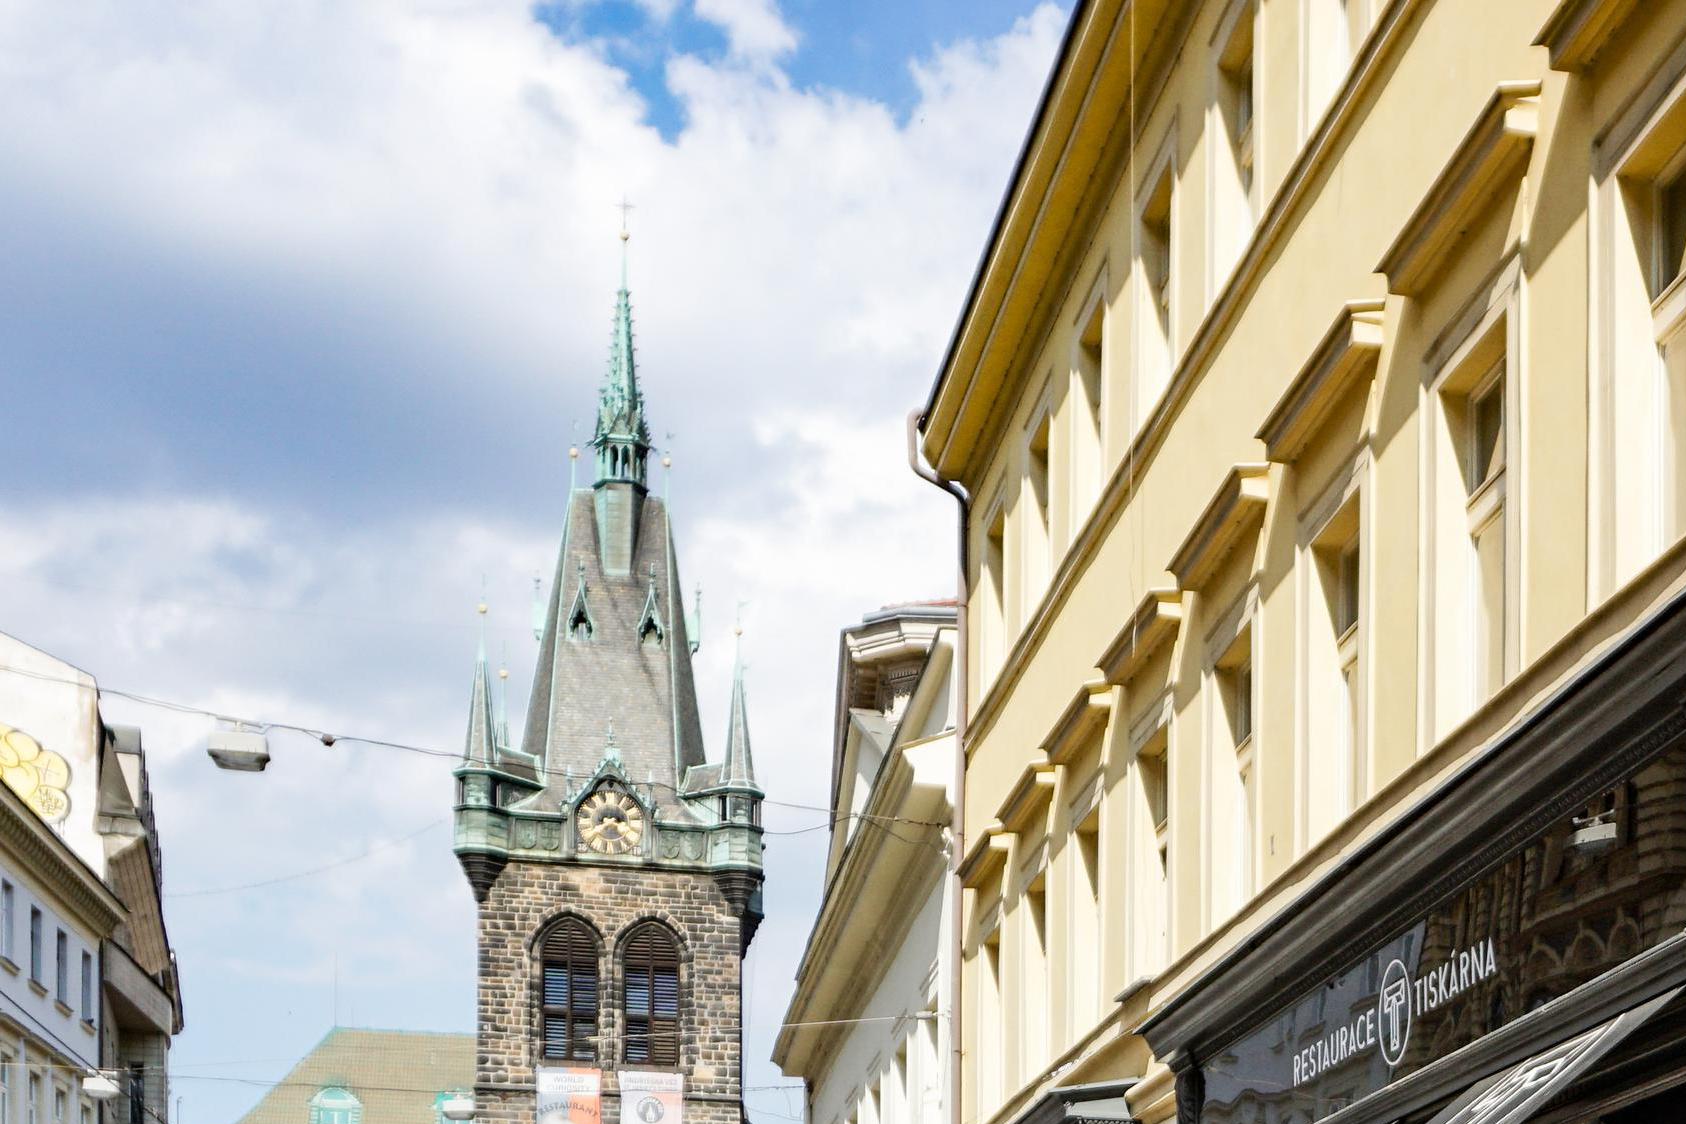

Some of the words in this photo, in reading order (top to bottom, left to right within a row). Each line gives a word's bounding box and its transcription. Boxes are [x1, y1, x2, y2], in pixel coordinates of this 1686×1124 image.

[1293, 1008, 1375, 1087] RESTAURACE
[1414, 936, 1497, 1017] TISKÁRNA
[538, 1101, 599, 1118] RESTAURANT
